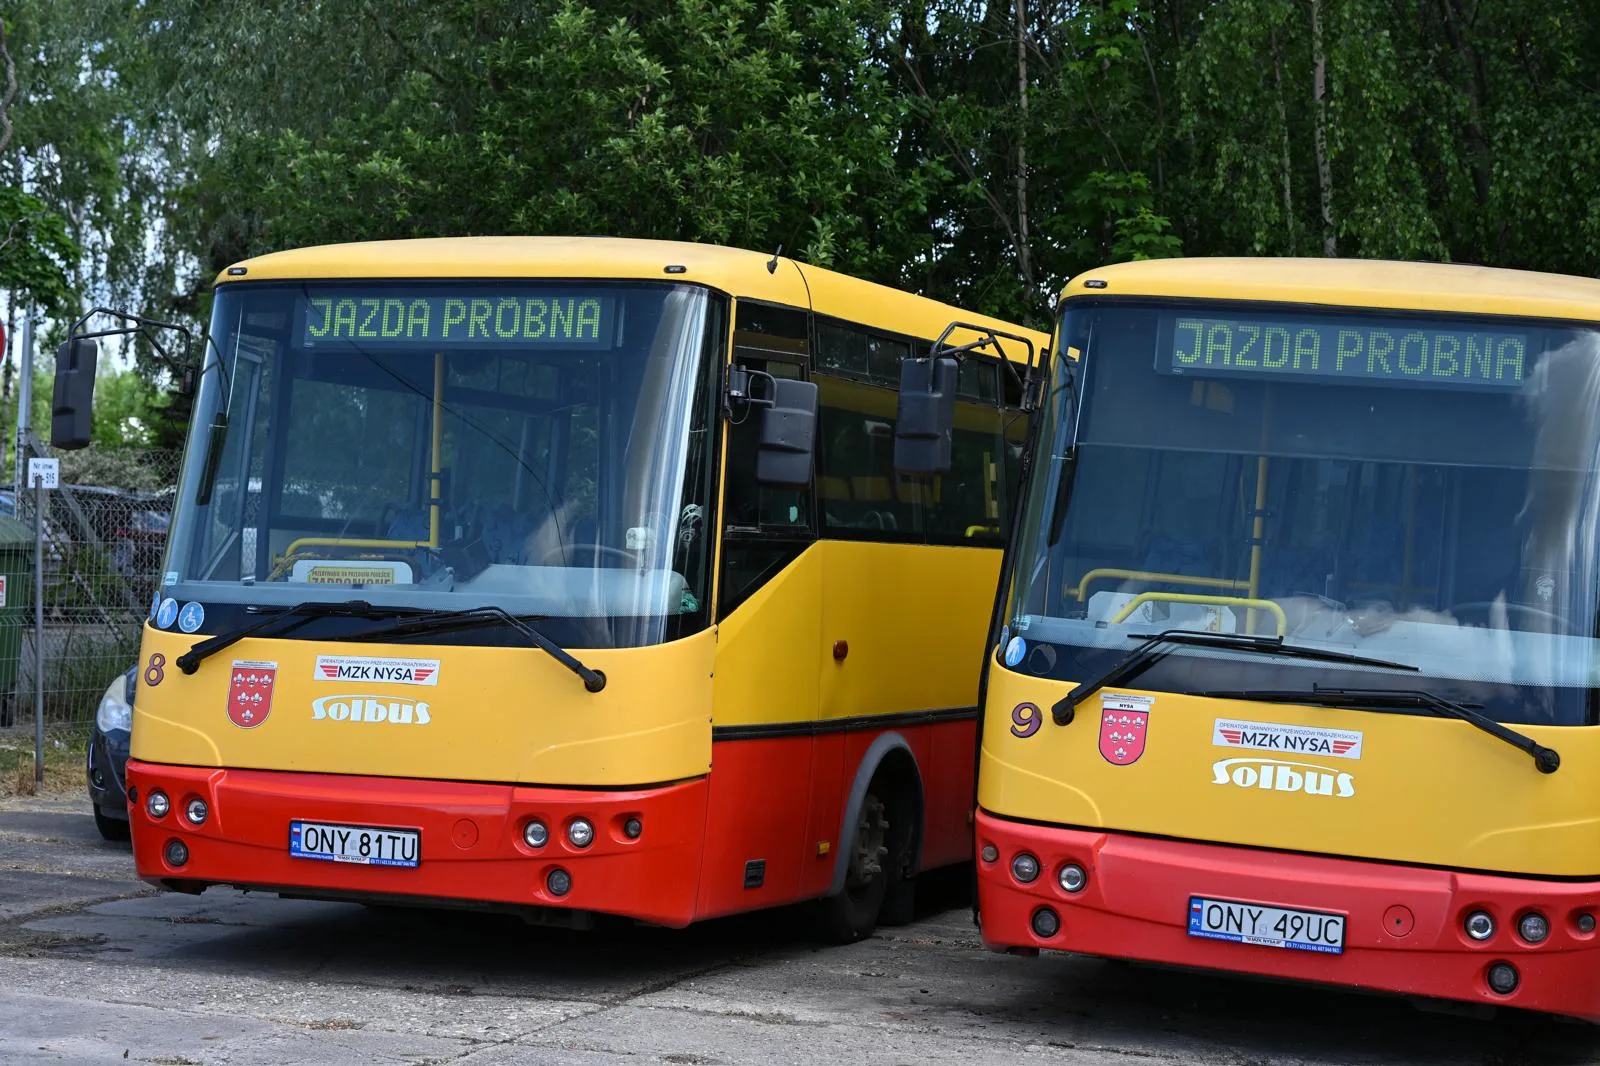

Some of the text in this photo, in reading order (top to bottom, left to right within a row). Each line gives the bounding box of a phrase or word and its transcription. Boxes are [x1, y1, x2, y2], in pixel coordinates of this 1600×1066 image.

[309, 297, 601, 339] JAZDA PRÓBNA
[1175, 321, 1525, 381] JAZDA PRÓBNA
[144, 653, 166, 687] 8
[338, 665, 413, 681] MZK NYSA
[312, 694, 431, 724] Solbus
[1010, 702, 1043, 739] 9
[1241, 731, 1331, 754] MZK NYSA
[1212, 757, 1355, 798] Solbus
[292, 840, 300, 848] PL
[304, 827, 416, 861] ONY 81TU
[1191, 917, 1201, 926] PL
[1206, 904, 1341, 945] ONY 49UC
